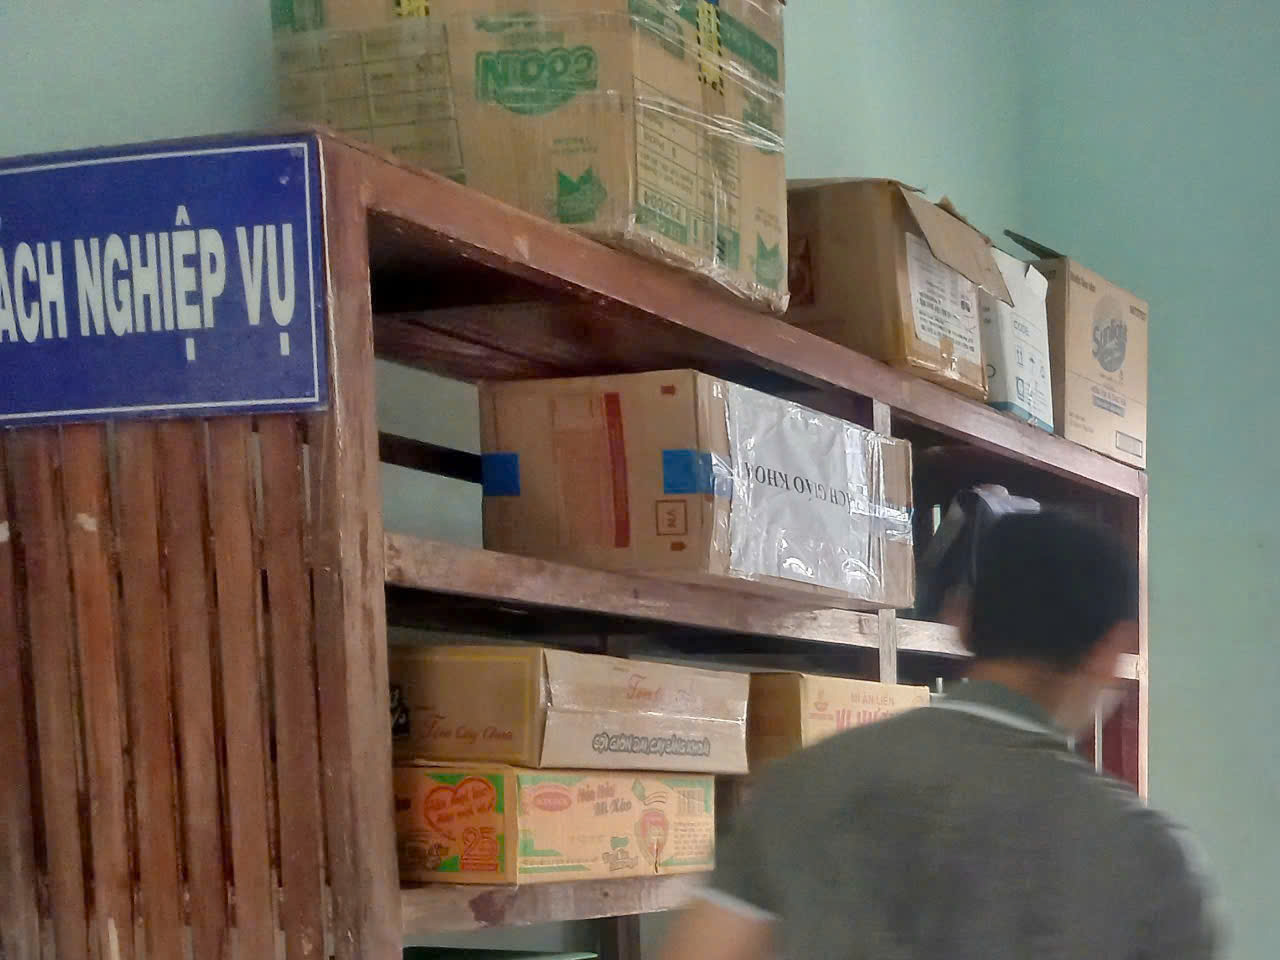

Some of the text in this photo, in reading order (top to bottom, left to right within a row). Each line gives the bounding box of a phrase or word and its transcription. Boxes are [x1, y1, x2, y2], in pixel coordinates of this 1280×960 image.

[74, 205, 227, 361] NGHIỆP
[235, 223, 296, 356] VỤ
[793, 475, 827, 502] GIÁO
